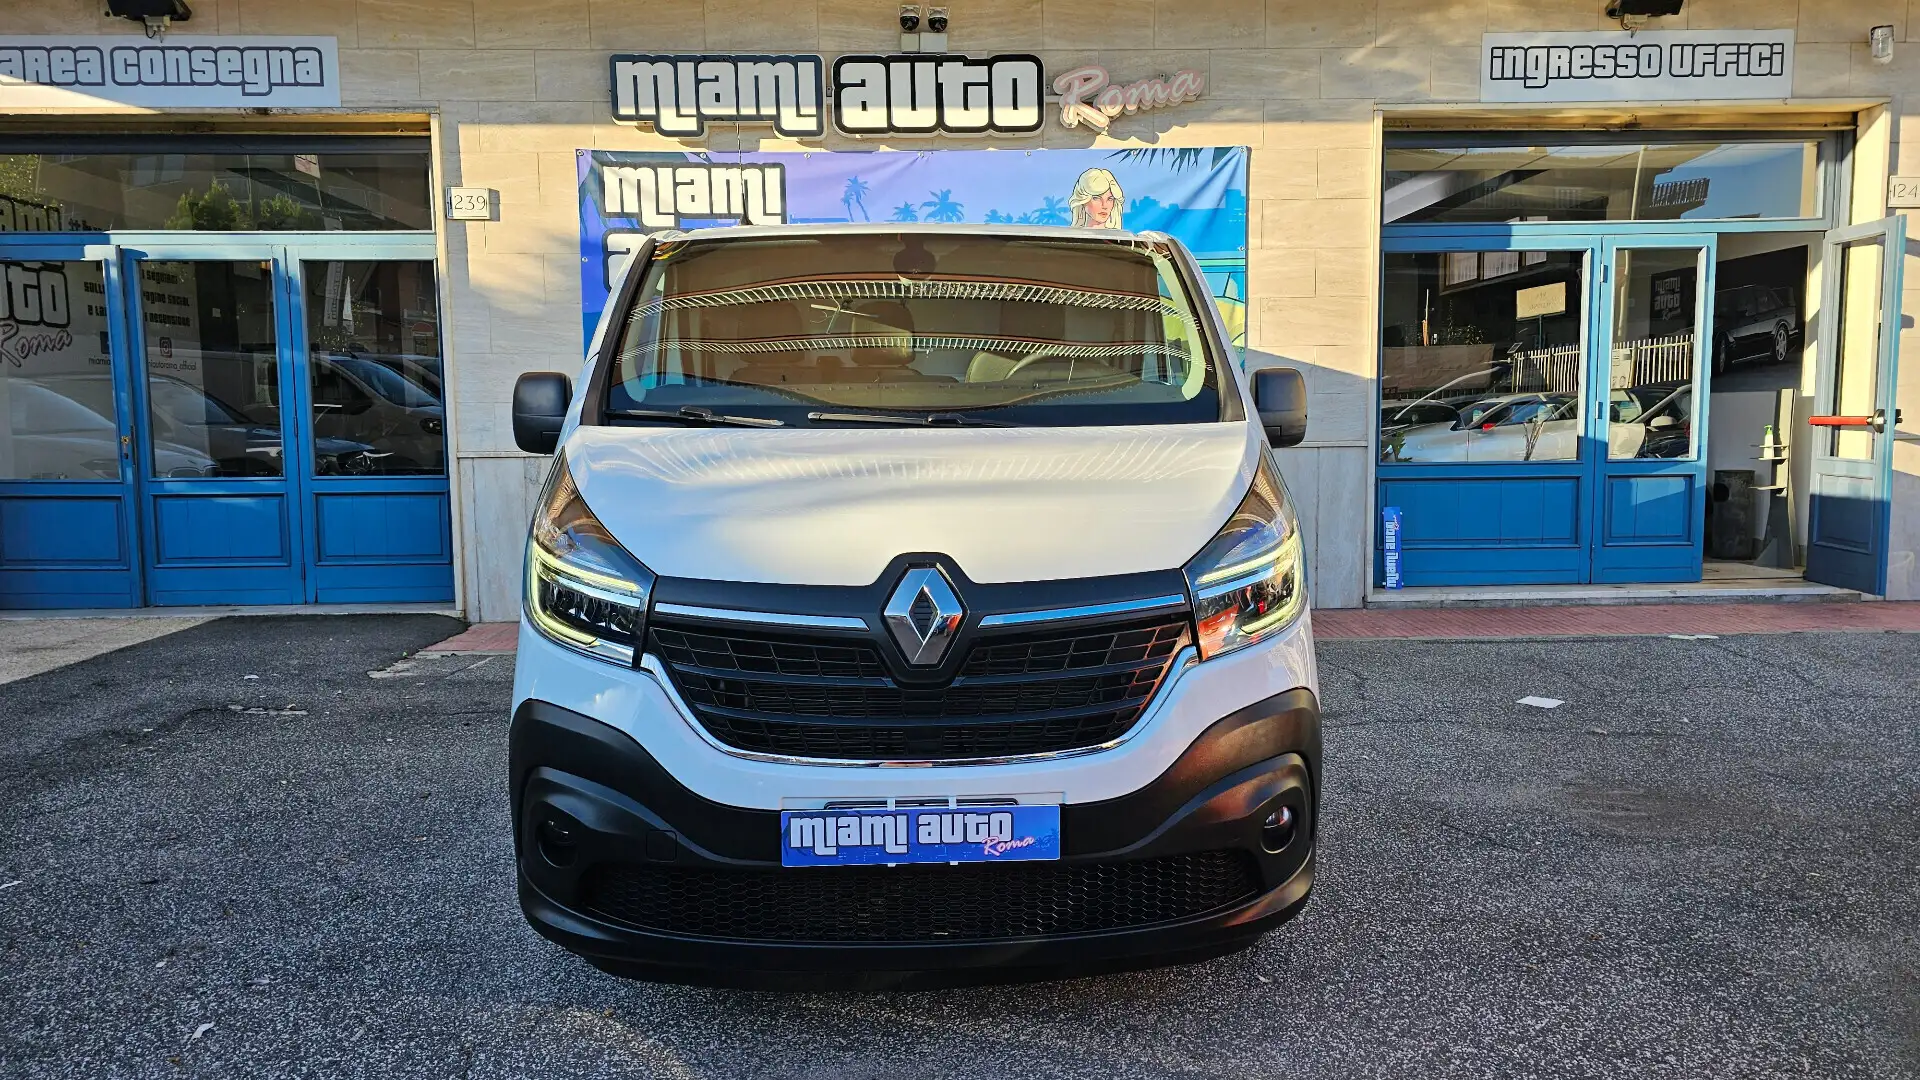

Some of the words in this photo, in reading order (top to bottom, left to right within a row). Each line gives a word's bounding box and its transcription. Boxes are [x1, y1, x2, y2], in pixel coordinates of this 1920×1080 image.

[110, 46, 324, 96] consegna
[1490, 46, 1662, 88] ingresso
[836, 58, 1041, 131] auto
[1053, 65, 1203, 133] Roma
[917, 812, 1013, 843] auto
[981, 835, 1035, 857] Roma
